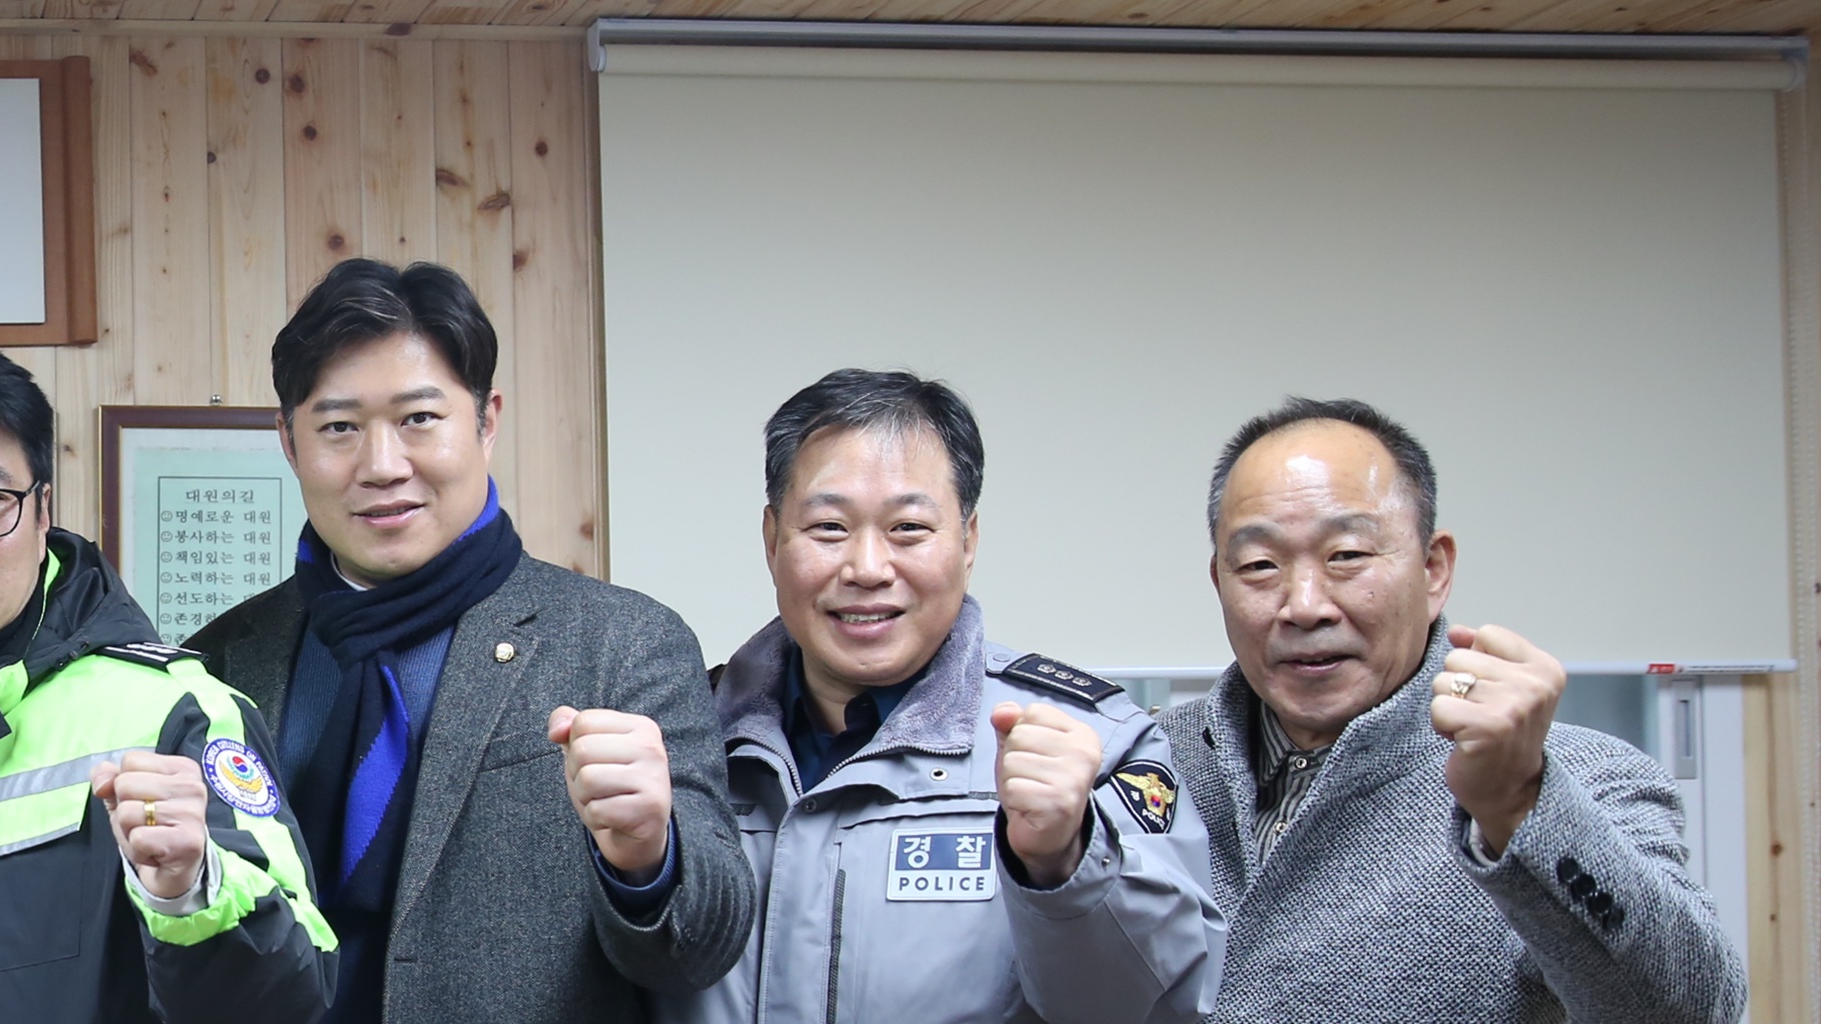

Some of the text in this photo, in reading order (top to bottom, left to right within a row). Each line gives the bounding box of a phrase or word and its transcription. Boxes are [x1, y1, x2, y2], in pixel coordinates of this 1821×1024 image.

[186, 489, 255, 503] 대원의길
[243, 510, 272, 524] 대원
[175, 530, 272, 545] 봉사하는 대원
[175, 551, 272, 565] 책임있는 대원
[174, 571, 272, 586] 노력하는 대원
[174, 592, 234, 606] 선도하는
[898, 877, 985, 891] POLICE
